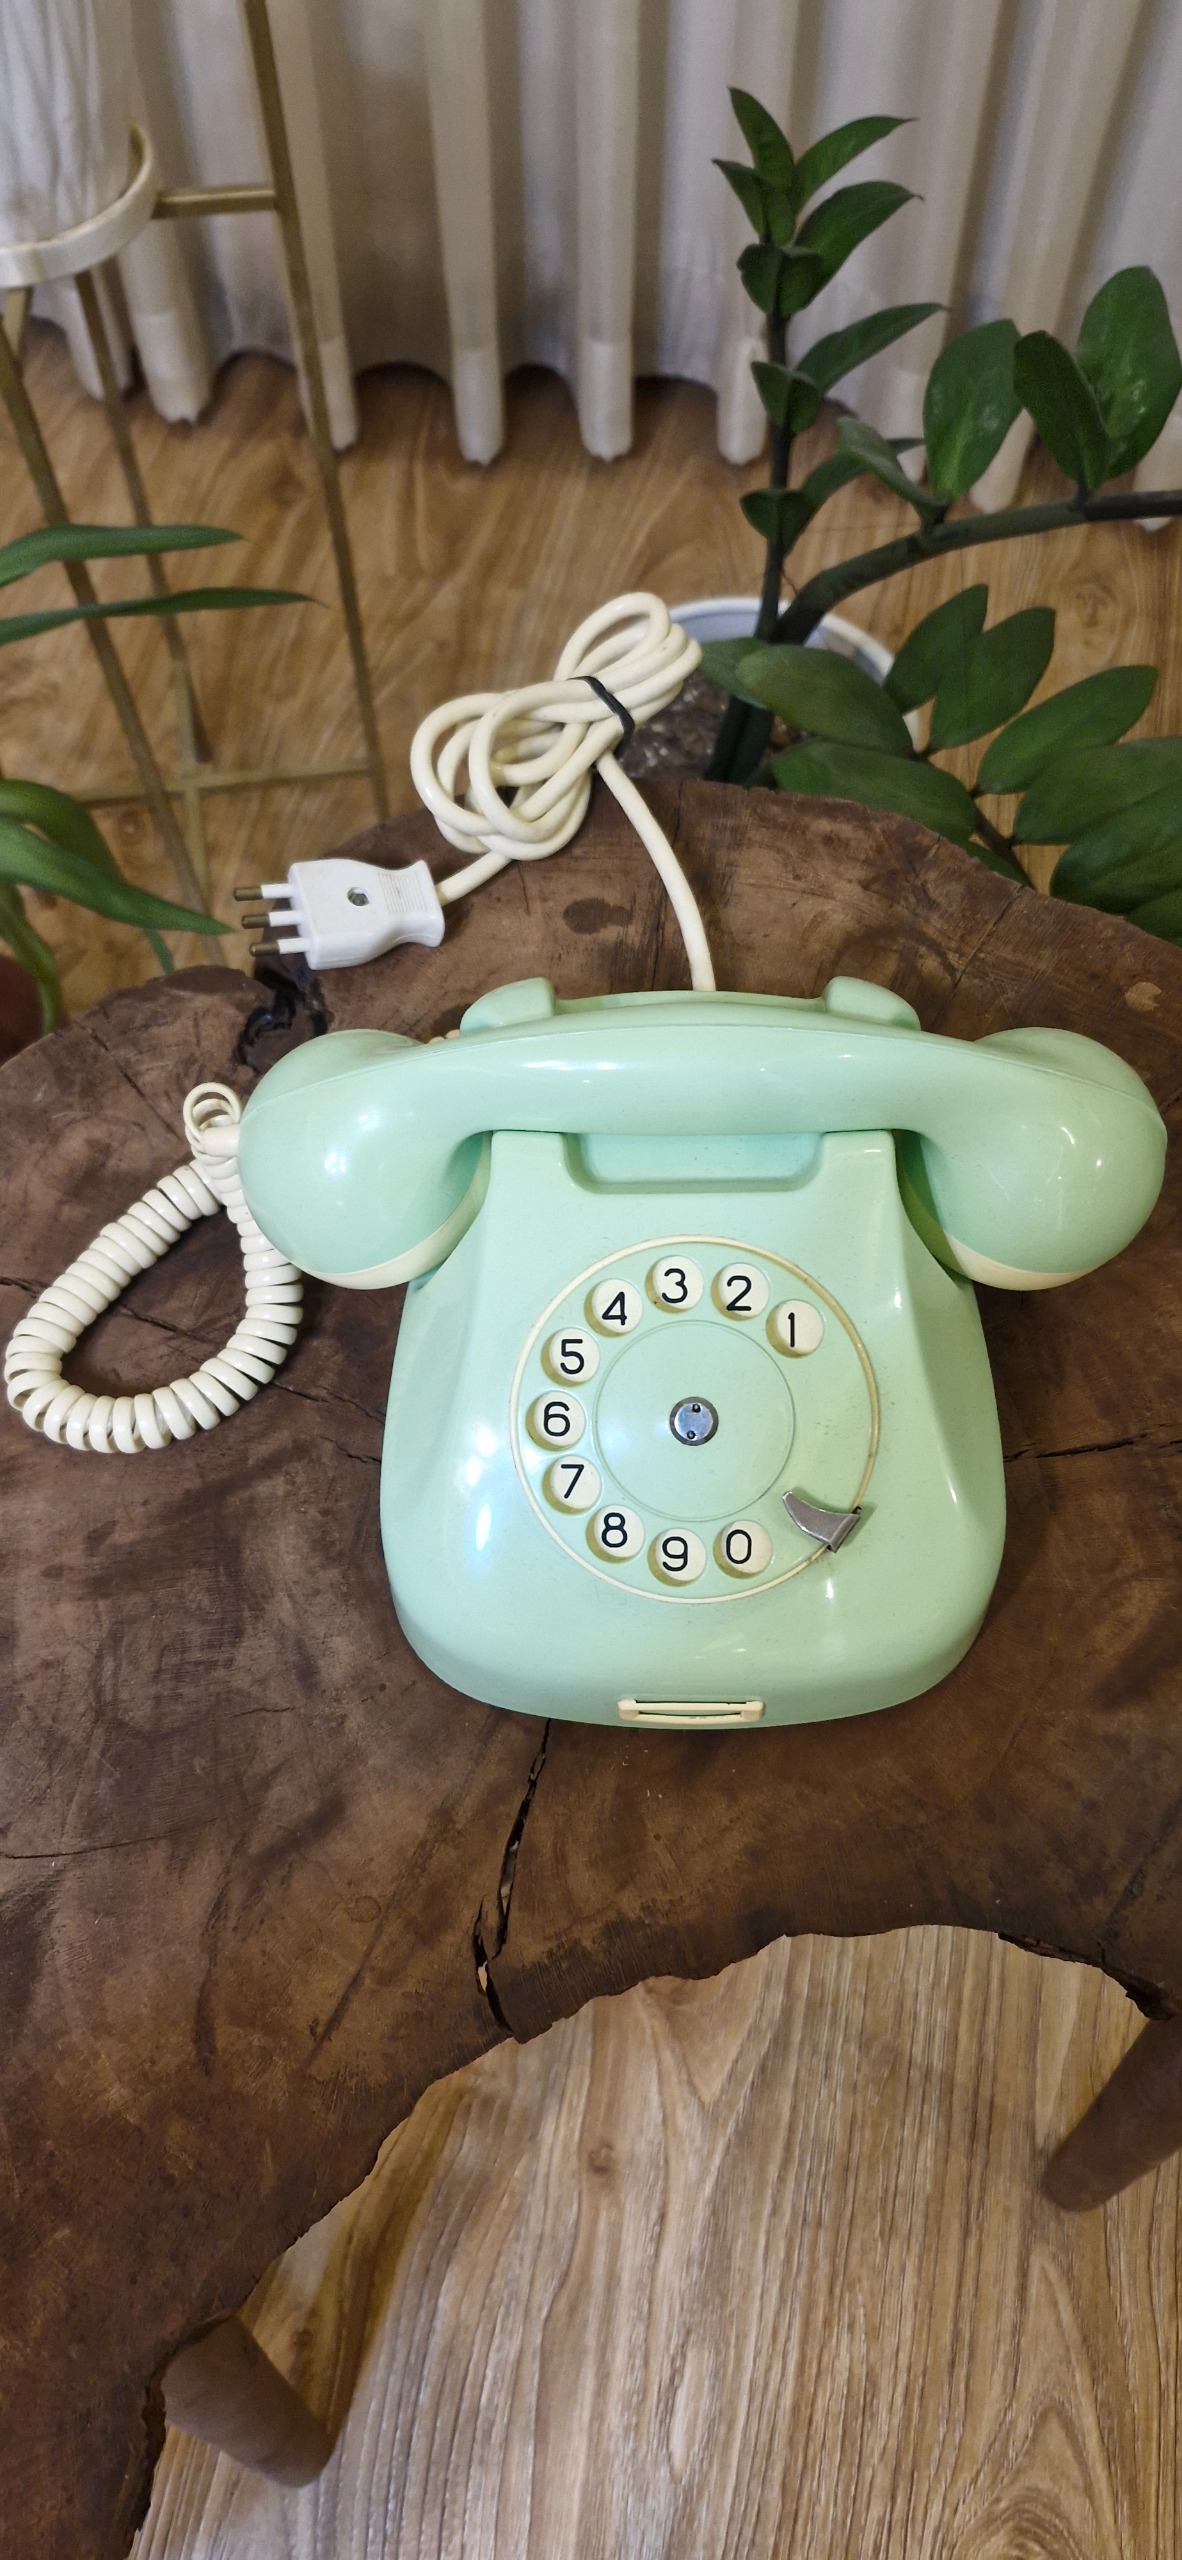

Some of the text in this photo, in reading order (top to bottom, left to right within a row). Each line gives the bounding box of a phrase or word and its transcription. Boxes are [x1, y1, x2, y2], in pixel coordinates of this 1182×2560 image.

[661, 1268, 688, 1304] 3
[725, 1275, 752, 1312] 2
[601, 1291, 628, 1326] 4
[786, 1312, 797, 1348] 1
[560, 1338, 585, 1375] 5
[543, 1401, 571, 1437] 6
[560, 1463, 585, 1499] 7
[601, 1512, 628, 1548] 8
[725, 1528, 753, 1565] 0
[661, 1536, 689, 1572] 9
